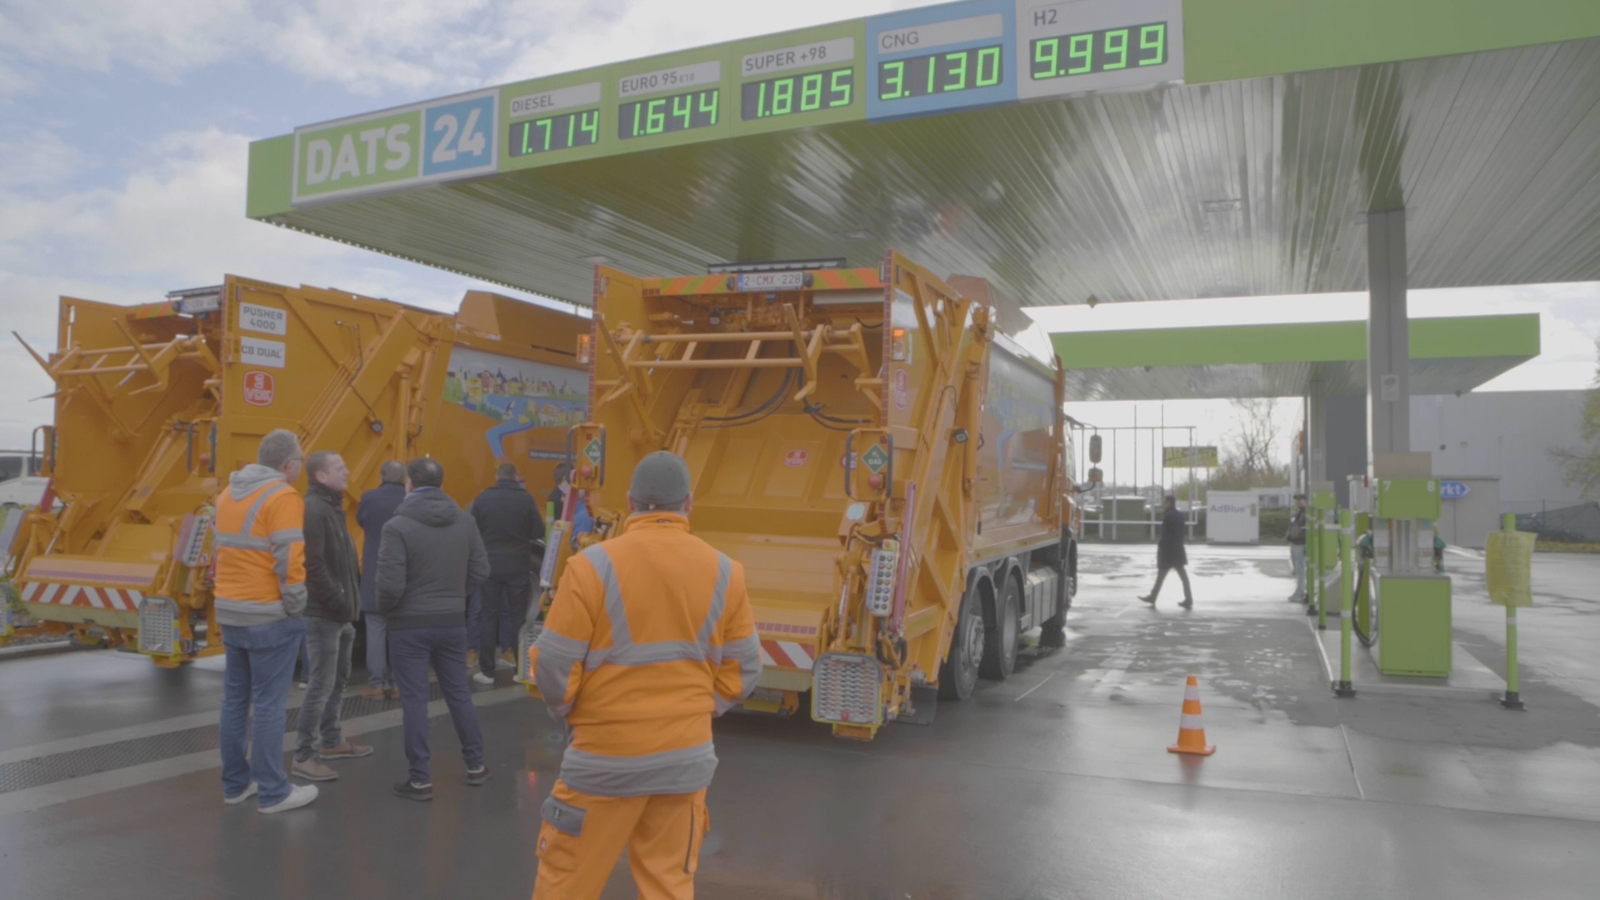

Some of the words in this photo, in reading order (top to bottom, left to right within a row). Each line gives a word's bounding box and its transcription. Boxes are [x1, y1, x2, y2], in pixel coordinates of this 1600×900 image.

[1033, 8, 1058, 26] H2
[881, 31, 920, 49] CNG
[1033, 23, 1165, 79] 9.999
[745, 50, 795, 72] SUPER
[800, 45, 827, 61] +98
[621, 75, 658, 93] EURO
[662, 71, 678, 86] 95
[881, 46, 1000, 100] 3.130
[511, 94, 555, 113] DIESEL
[757, 68, 852, 118] 1.885
[632, 90, 719, 137] 1.644
[521, 110, 599, 154] 1.714
[306, 123, 411, 185] DATS
[432, 107, 486, 164] 24
[243, 305, 284, 321] PUSHER
[249, 319, 276, 331] 4000
[1382, 480, 1392, 492] 7
